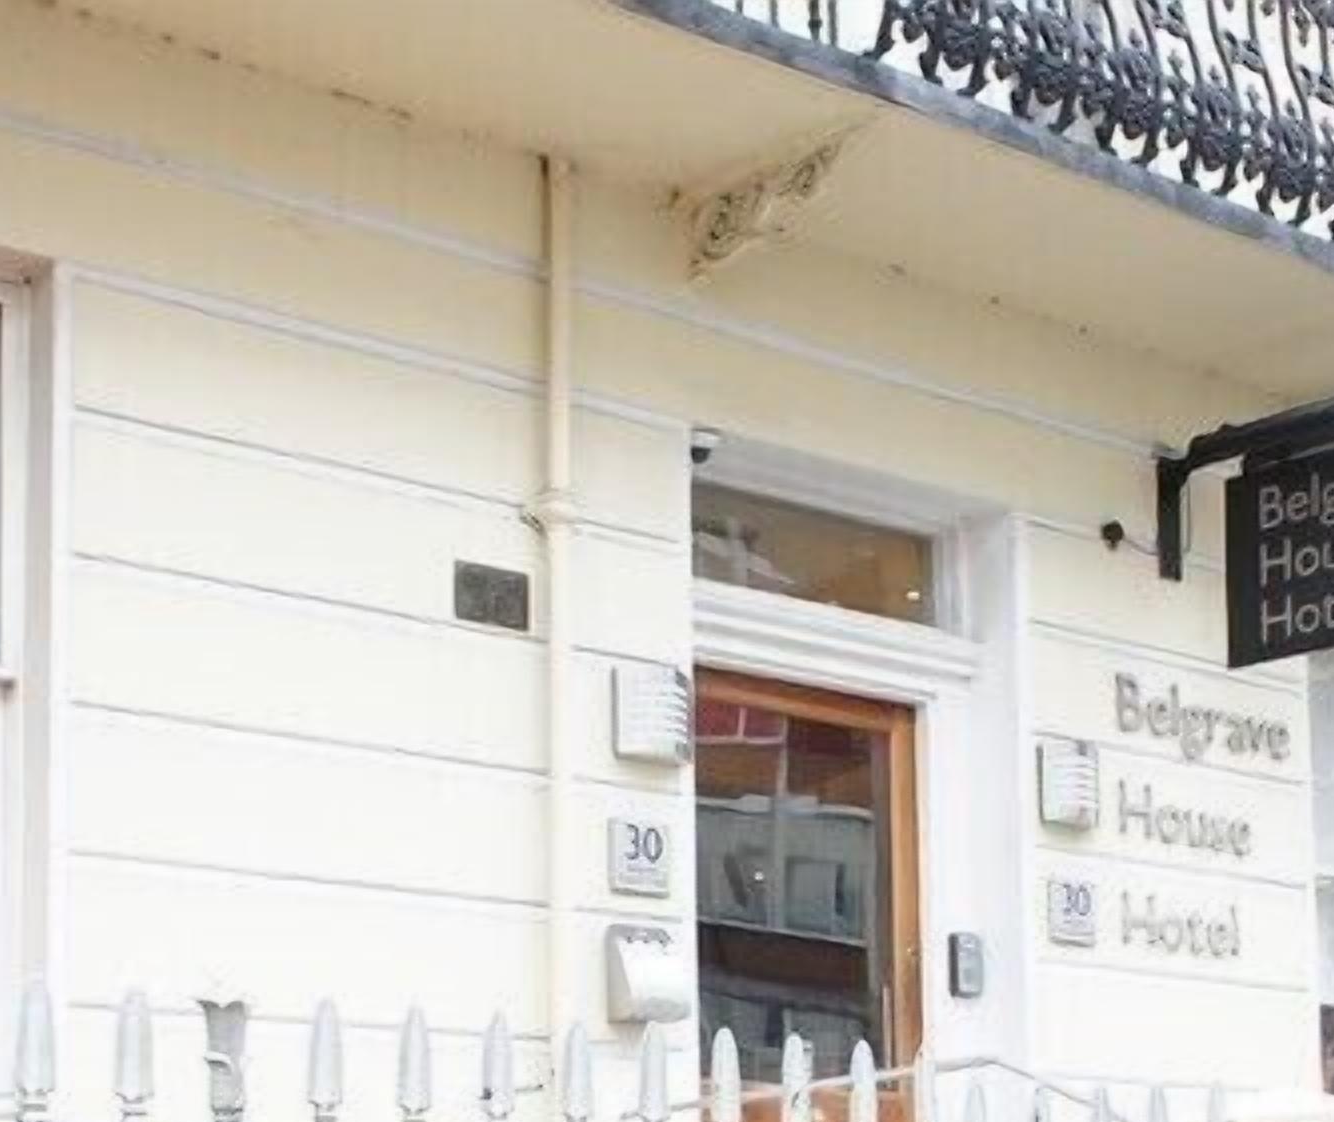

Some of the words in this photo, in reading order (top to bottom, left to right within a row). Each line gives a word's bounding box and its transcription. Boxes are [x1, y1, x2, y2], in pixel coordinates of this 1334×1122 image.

[1116, 673, 1291, 760] Belgrave
[624, 823, 664, 864] 30
[1119, 778, 1251, 857] House
[1058, 883, 1092, 917] 30
[1121, 890, 1241, 957] Hotel
